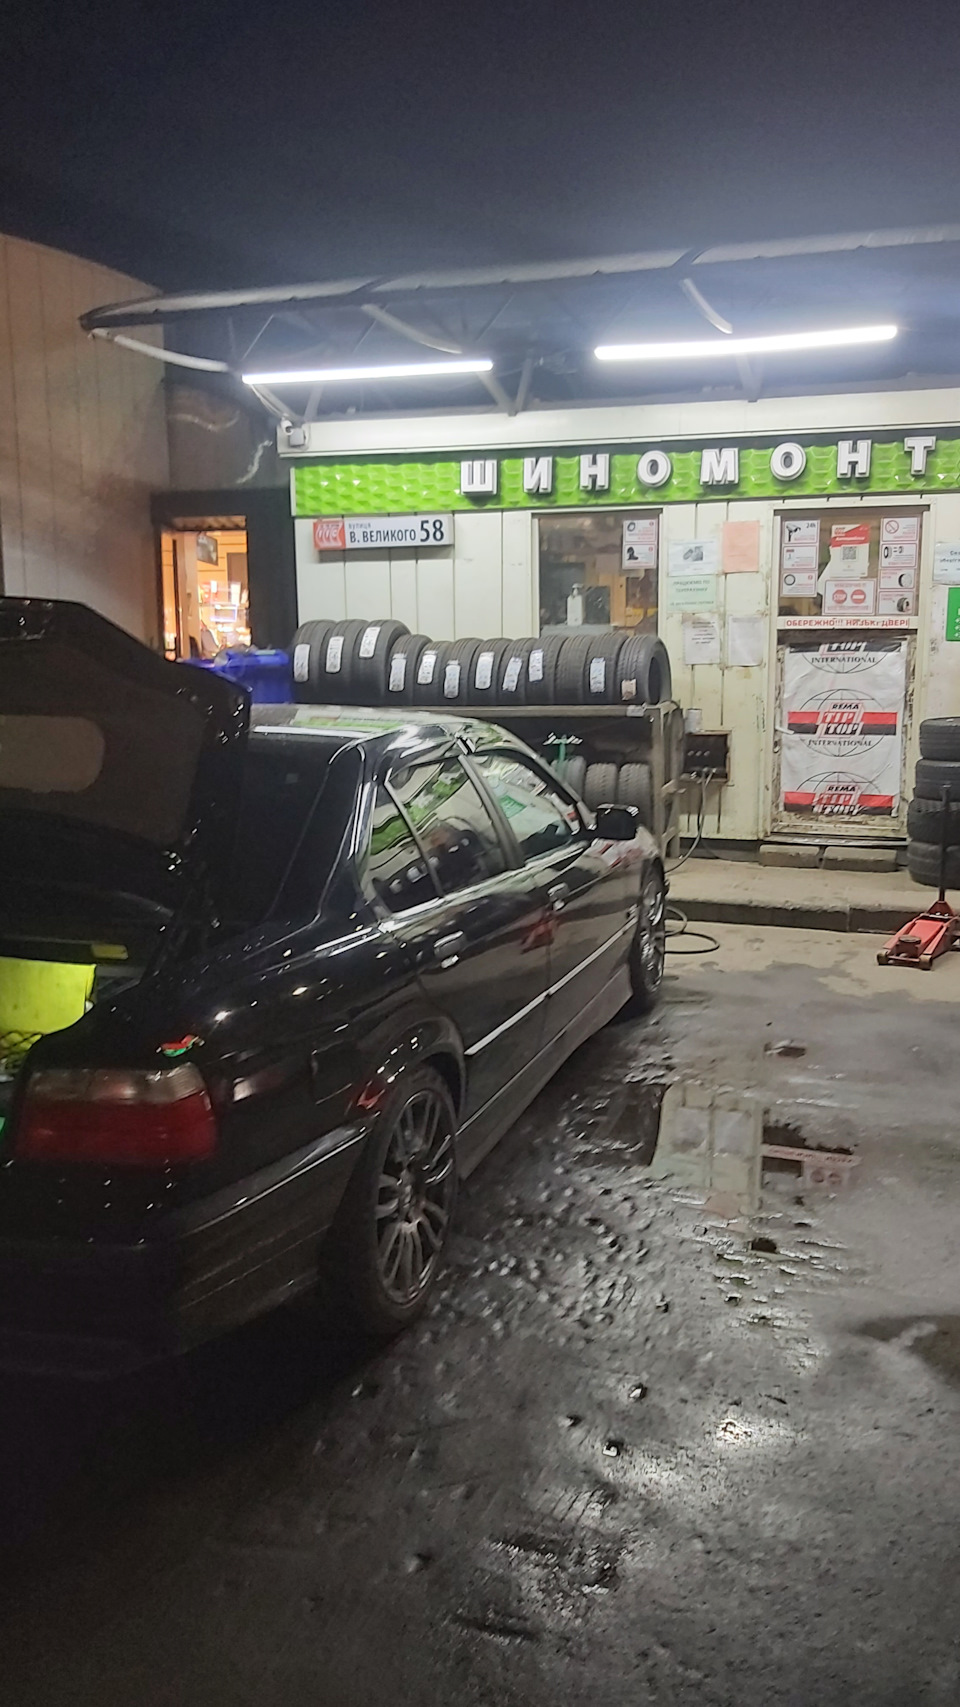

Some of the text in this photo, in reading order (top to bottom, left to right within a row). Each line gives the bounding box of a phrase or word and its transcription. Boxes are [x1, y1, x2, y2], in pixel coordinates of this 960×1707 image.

[460, 436, 936, 495] ШИНОМОНТ
[350, 531, 360, 543] В.
[362, 529, 416, 543] ВЕЛИКОГО
[420, 519, 444, 542] 58
[881, 619, 909, 628] ДВЕРІ
[823, 712, 855, 723] TIP
[827, 723, 859, 735] TOP
[819, 793, 852, 804] TIP
